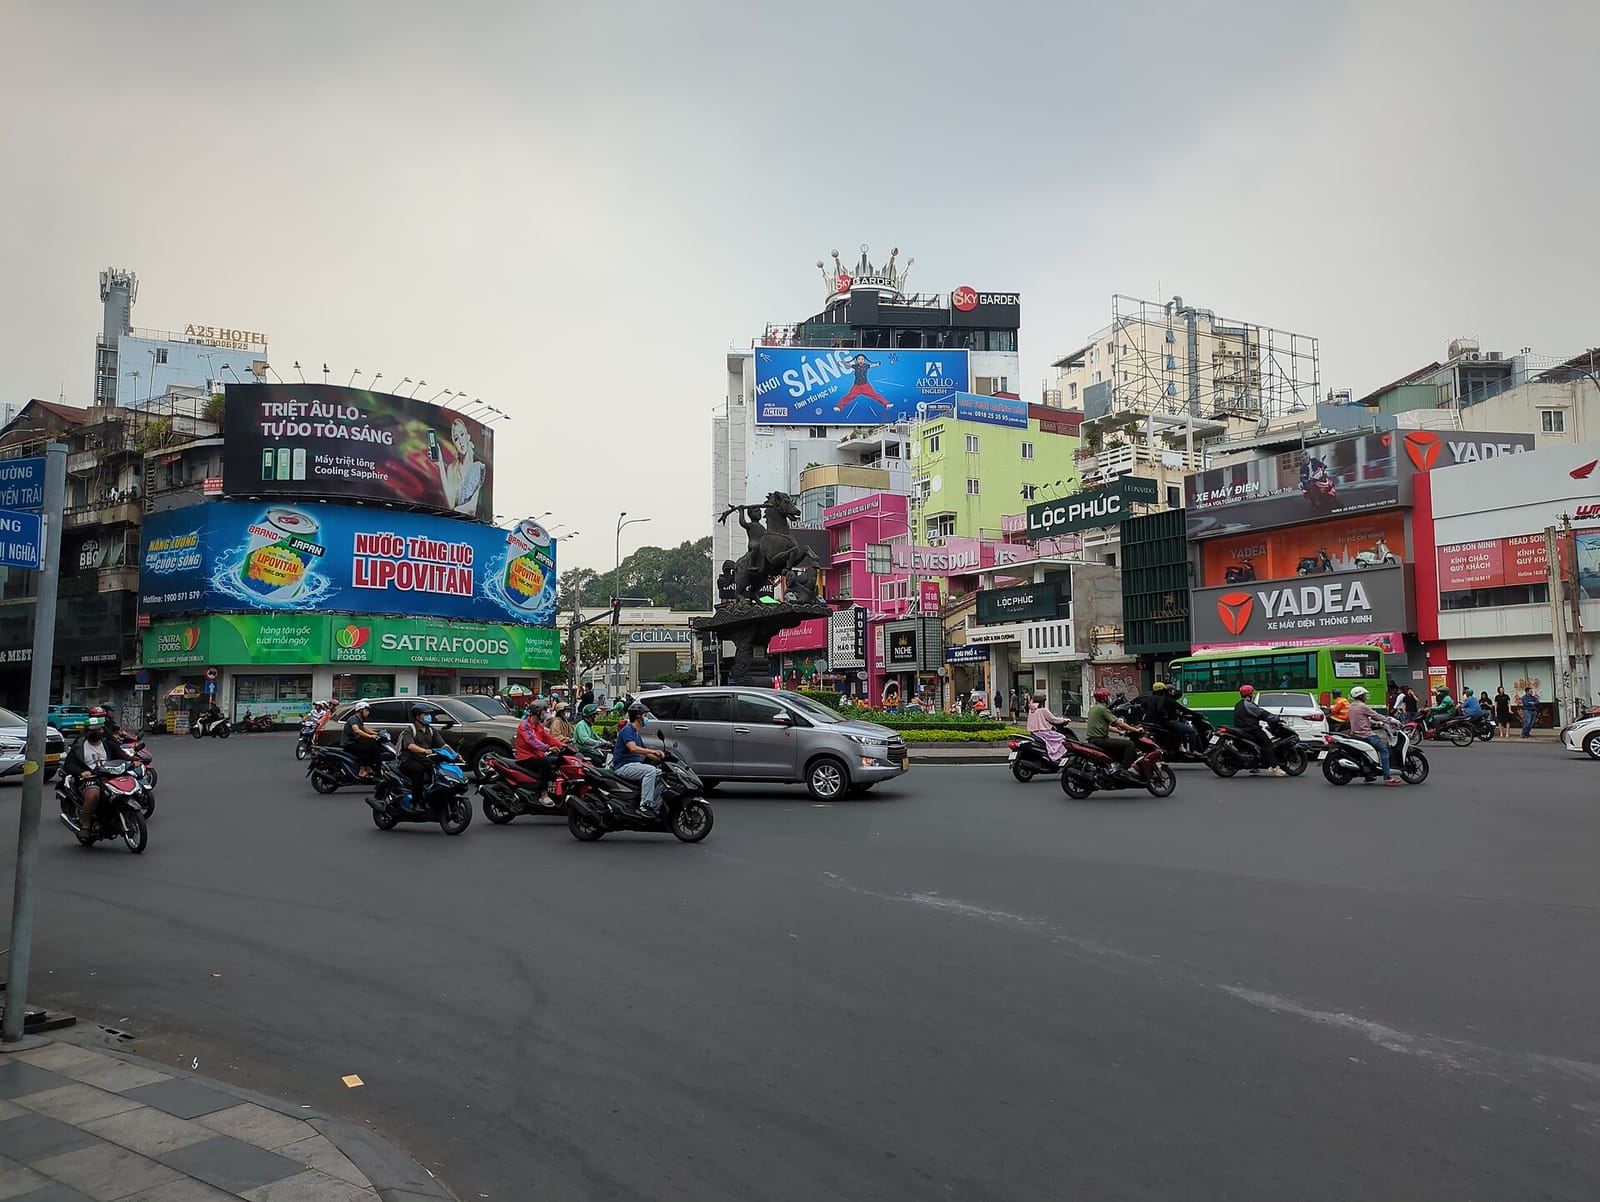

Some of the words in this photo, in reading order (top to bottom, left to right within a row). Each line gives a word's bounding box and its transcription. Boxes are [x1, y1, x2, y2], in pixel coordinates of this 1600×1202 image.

[852, 277, 896, 288] GARDEN
[954, 290, 978, 306] SKY
[980, 294, 1020, 304] GARDEN
[185, 324, 214, 338] A25
[220, 328, 266, 344] HOTEL
[916, 378, 954, 386] APOLLO
[261, 400, 308, 420] TRIỆT
[310, 400, 334, 418] ÂU
[337, 404, 359, 420] LO
[764, 408, 787, 416] ACTIVE
[286, 422, 312, 437] DO
[313, 420, 350, 440] TỎA
[350, 424, 393, 446] SÁNG
[315, 454, 334, 464] Máy
[315, 466, 350, 478] Cooling
[350, 466, 388, 482] Sapphire
[1196, 492, 1209, 502] XE
[1211, 486, 1233, 500] MÁY
[1030, 506, 1066, 531] LỘC
[1069, 493, 1121, 522] PHÚC
[0, 519, 22, 532] NG
[291, 540, 323, 556] JAPAN
[356, 532, 404, 556] NƯỚC
[408, 536, 448, 561] TĂNG
[1443, 545, 1460, 554] HEAD
[1462, 543, 1476, 552] SƠN
[1477, 540, 1496, 550] MINH
[1508, 538, 1528, 546] HEAD
[8, 543, 36, 562] NGHĨA
[1231, 545, 1266, 559] YADEA
[1468, 553, 1489, 562] CHÀO
[1517, 549, 1535, 557] KÍNH
[257, 553, 299, 574] LIPOVITAN
[1466, 562, 1490, 570] KHÁCH
[354, 558, 473, 596] LIPOVITAN
[997, 596, 1012, 608] LỘC
[1013, 592, 1034, 605] PHÚC
[1257, 581, 1372, 619] YADEA
[1279, 619, 1295, 629] MÁY
[1297, 618, 1316, 629] ĐIỆN
[1319, 615, 1348, 626] THÔNG
[1351, 614, 1372, 624] MINH
[158, 634, 180, 644] SATRA
[631, 631, 672, 641] CICILIA
[159, 643, 180, 652] FOODS
[381, 633, 509, 655] SATRAFOODS
[895, 646, 912, 654] NICHE
[8, 649, 32, 661] MEET
